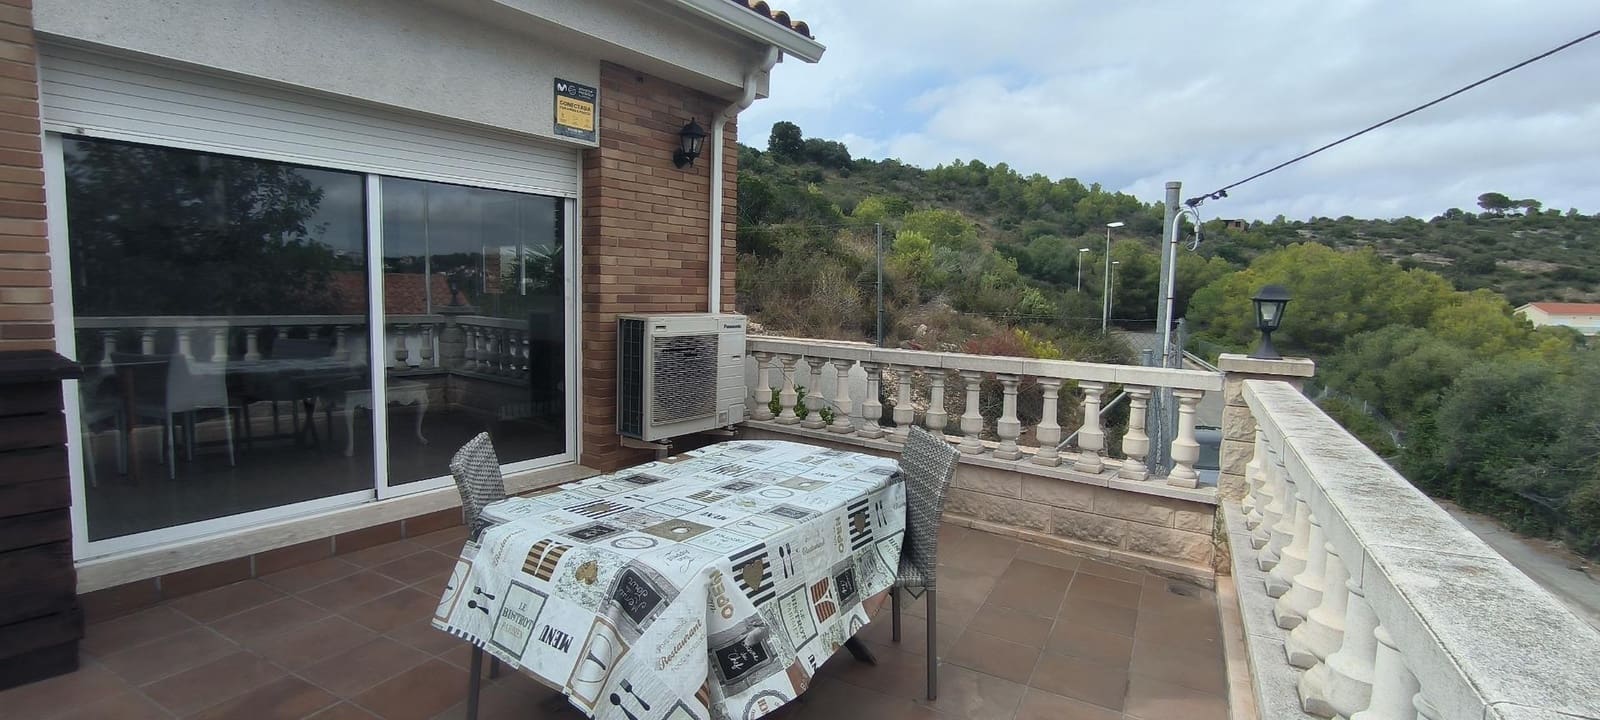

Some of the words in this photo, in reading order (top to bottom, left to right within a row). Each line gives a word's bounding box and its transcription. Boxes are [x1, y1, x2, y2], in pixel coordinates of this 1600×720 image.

[502, 607, 534, 630] BISTROT
[538, 624, 574, 654] MENU
[659, 619, 702, 671] Restaurant
